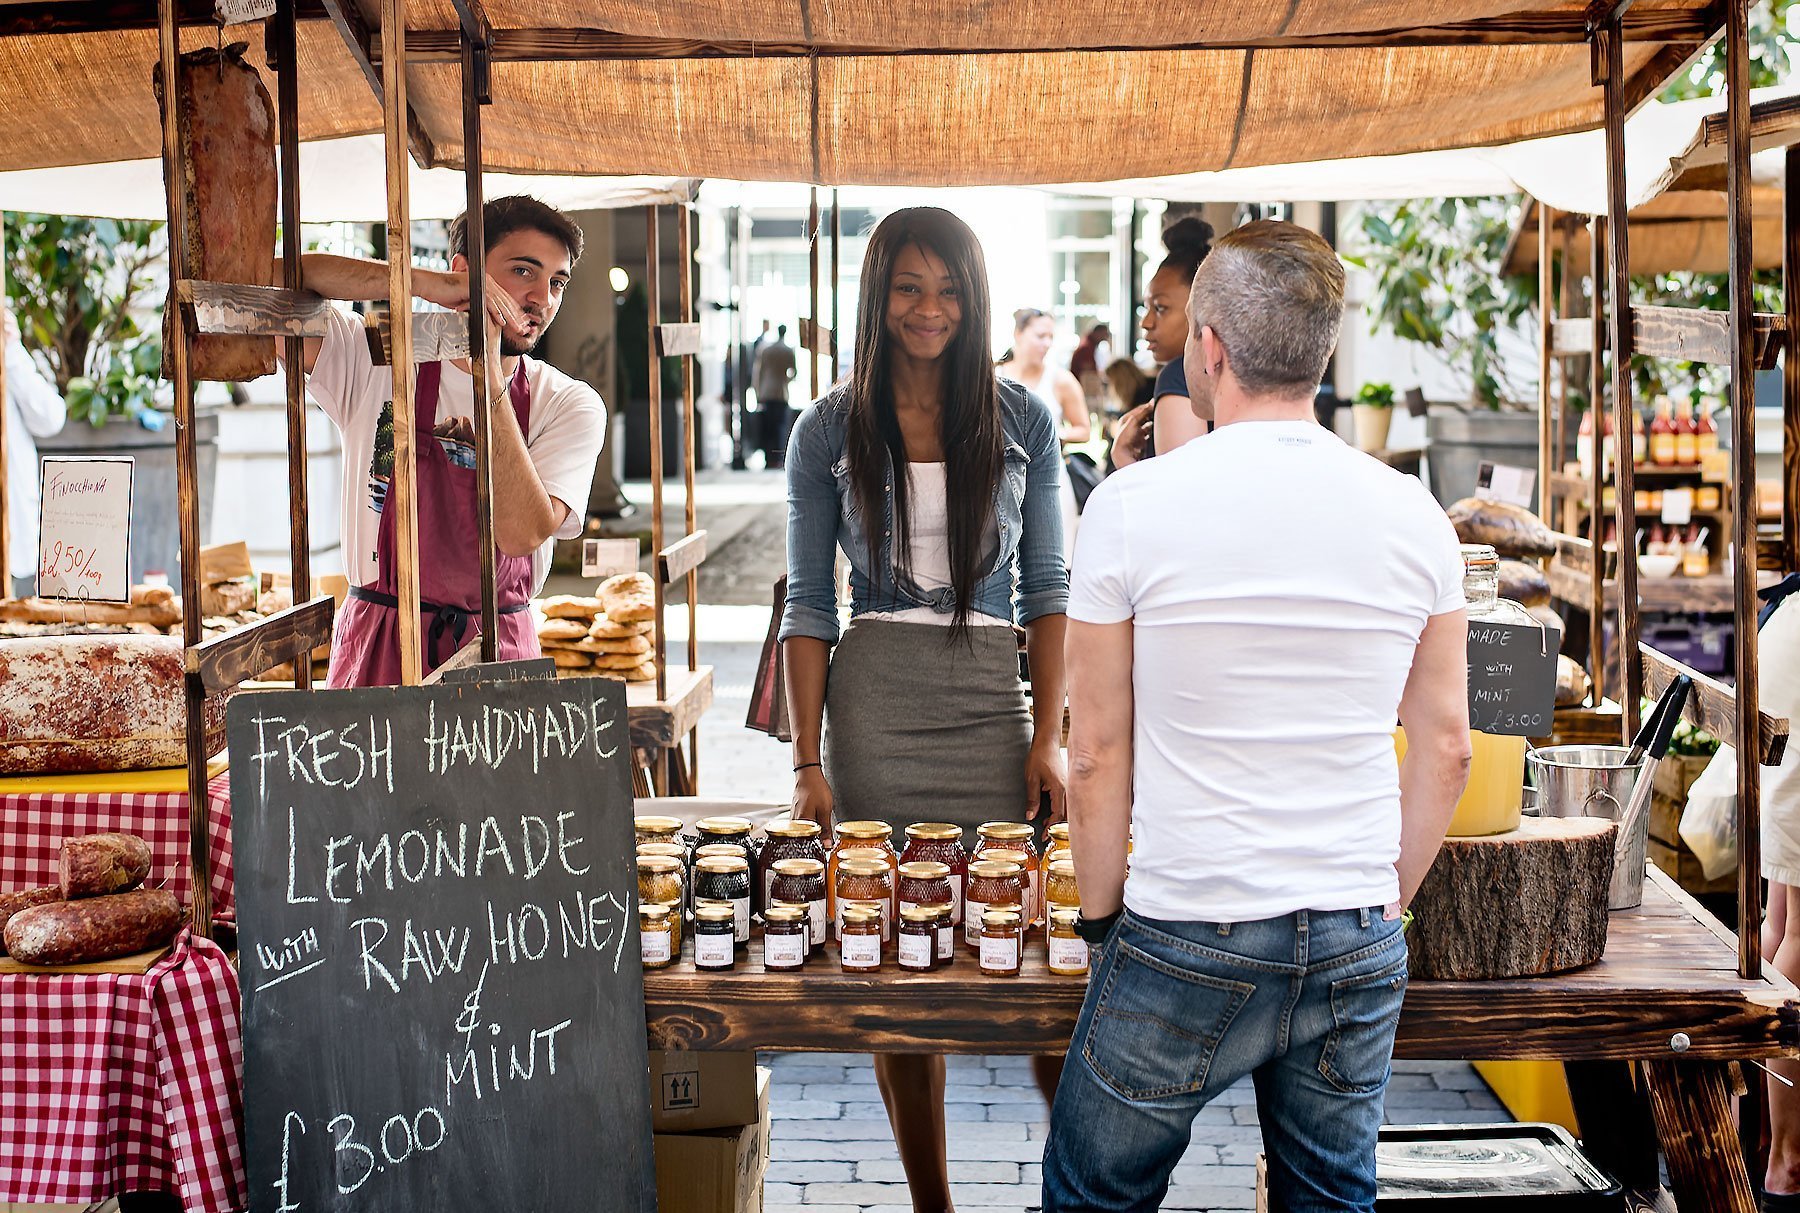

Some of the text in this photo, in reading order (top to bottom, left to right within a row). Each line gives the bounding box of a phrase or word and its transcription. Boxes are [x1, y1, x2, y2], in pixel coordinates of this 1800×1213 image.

[250, 697, 618, 797] FRESH HANDMADE
[286, 806, 591, 904] LEMONADE
[349, 917, 470, 993] RAW
[487, 891, 630, 974] HONEY
[455, 959, 488, 1050] &
